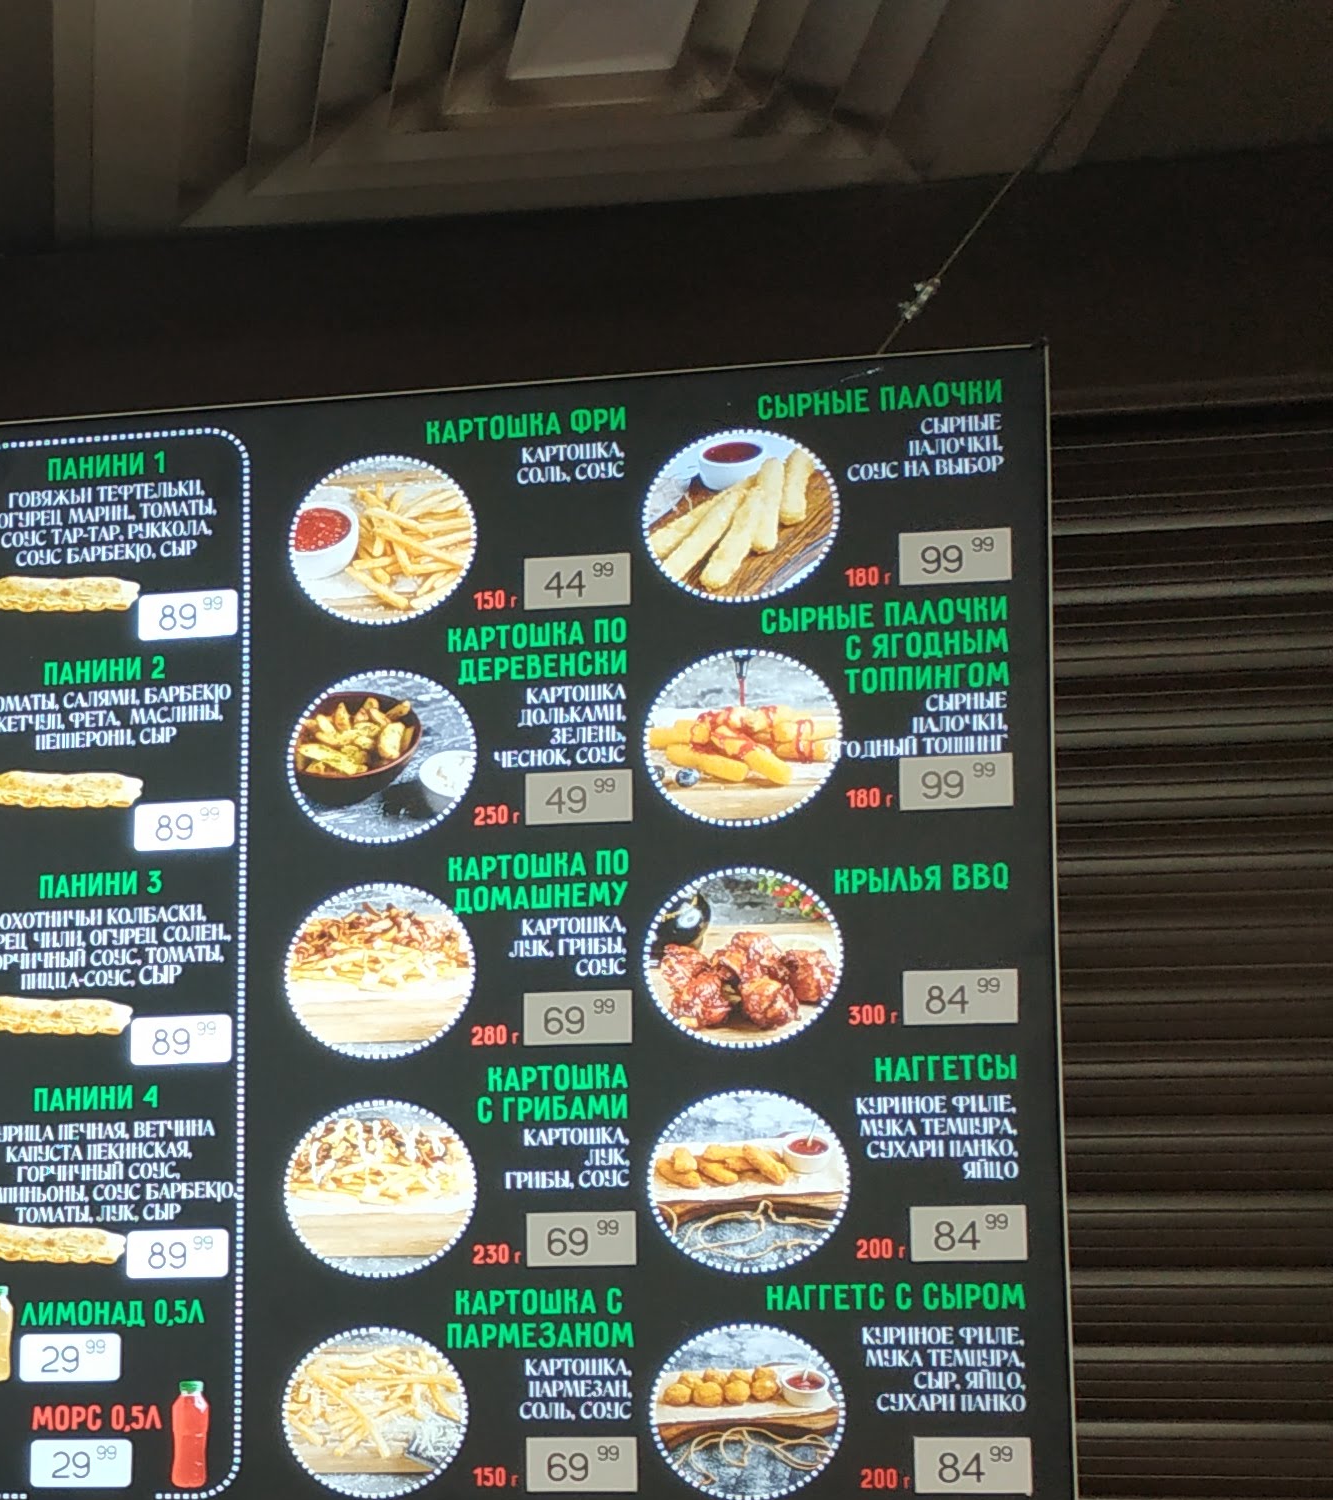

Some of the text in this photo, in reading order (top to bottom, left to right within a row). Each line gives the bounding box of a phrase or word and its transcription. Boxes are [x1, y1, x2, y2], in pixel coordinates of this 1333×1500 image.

[758, 380, 1001, 420] СЫРНЫЕ ПАЛОЧКИ
[427, 407, 625, 444] КАРТОШКА ФРИ
[921, 414, 1000, 437] СЫРНЫЕ
[48, 451, 164, 481] ПАНИНИ 1
[576, 462, 624, 480] СОУС
[848, 456, 1004, 481] СОУС НА ВЫБОР
[1, 530, 49, 551] СОУС
[847, 567, 879, 586] 180
[761, 596, 1007, 640] СЫРНЫЕ ПАЛОЧКИ
[448, 617, 627, 657] КАРТОШКА ПО
[846, 624, 1008, 660] С ЯГОДНЫМ
[44, 656, 165, 685] ПАНИНИ 2
[456, 647, 627, 685] ДЕРЕВЕНСКИ
[844, 659, 1009, 694] ТОППИНГОМ
[527, 684, 626, 708] КАРТОШКА
[448, 848, 629, 885] КАРТОШКА ПО
[834, 862, 1008, 894] КРЫЛЬЯ BBQ
[40, 870, 162, 899] ПАНИНИ 3
[451, 878, 628, 915] ДОМАШНЕМУ
[488, 1064, 628, 1092] КАРТОШКА
[875, 1054, 1017, 1082] НАГГЕТСЫ
[34, 1085, 158, 1112] ПАНИНИ 4
[477, 1090, 627, 1123] С ГРИБАМИ
[856, 1096, 947, 1114] КУРИНОЕ
[455, 1288, 622, 1315] КАРТОШКА С
[767, 1282, 1025, 1310] НАГГЕТС С СЫРОМ
[21, 1300, 145, 1327] ЛИМОНАД
[447, 1321, 634, 1348] ПАРМЕЗАНОМ
[32, 1405, 101, 1431] МОРС
[861, 1469, 897, 1488] 200
